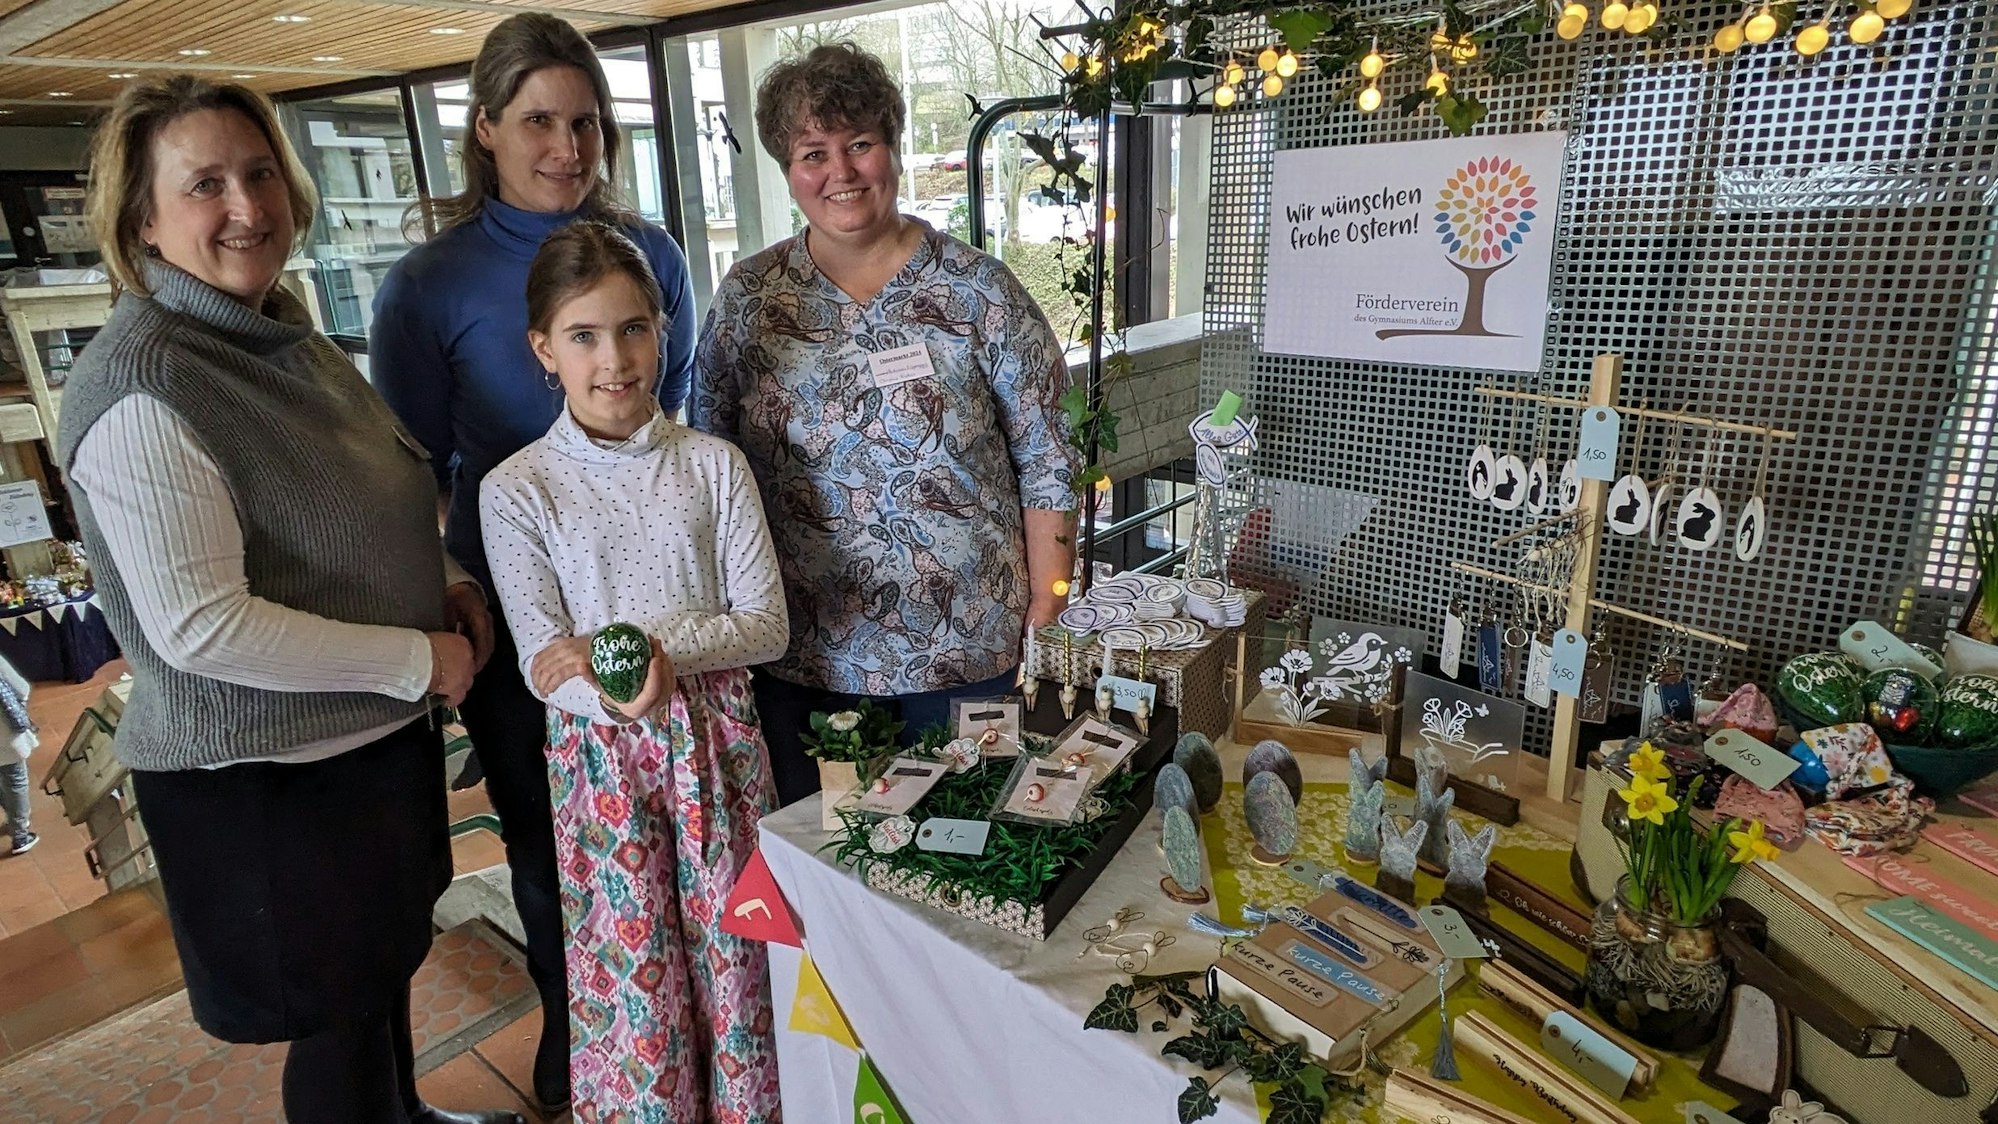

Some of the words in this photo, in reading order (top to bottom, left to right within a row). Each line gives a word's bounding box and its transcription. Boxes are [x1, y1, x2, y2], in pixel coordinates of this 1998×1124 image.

[1286, 203, 1315, 224] Wir
[1321, 187, 1422, 218] wünschen
[1291, 226, 1340, 250] frohe
[1347, 212, 1419, 243] Ostern!
[1355, 293, 1459, 313] Förderverein
[1354, 314, 1367, 323] des
[1368, 315, 1418, 326] Gymnasiums
[1420, 317, 1443, 327] Alfter
[1444, 318, 1459, 327] e.V.
[1583, 446, 1607, 461] 1,50
[593, 634, 641, 657] Frohe
[591, 652, 644, 675] Ostern
[1552, 663, 1575, 681] 4,50
[1115, 686, 1137, 698] 3,50
[1733, 747, 1762, 768] 1,50
[944, 828, 965, 844] 1,-
[1278, 969, 1324, 999] Pause
[1337, 971, 1386, 1000] Pause
[1572, 1039, 1594, 1064] 4,-
